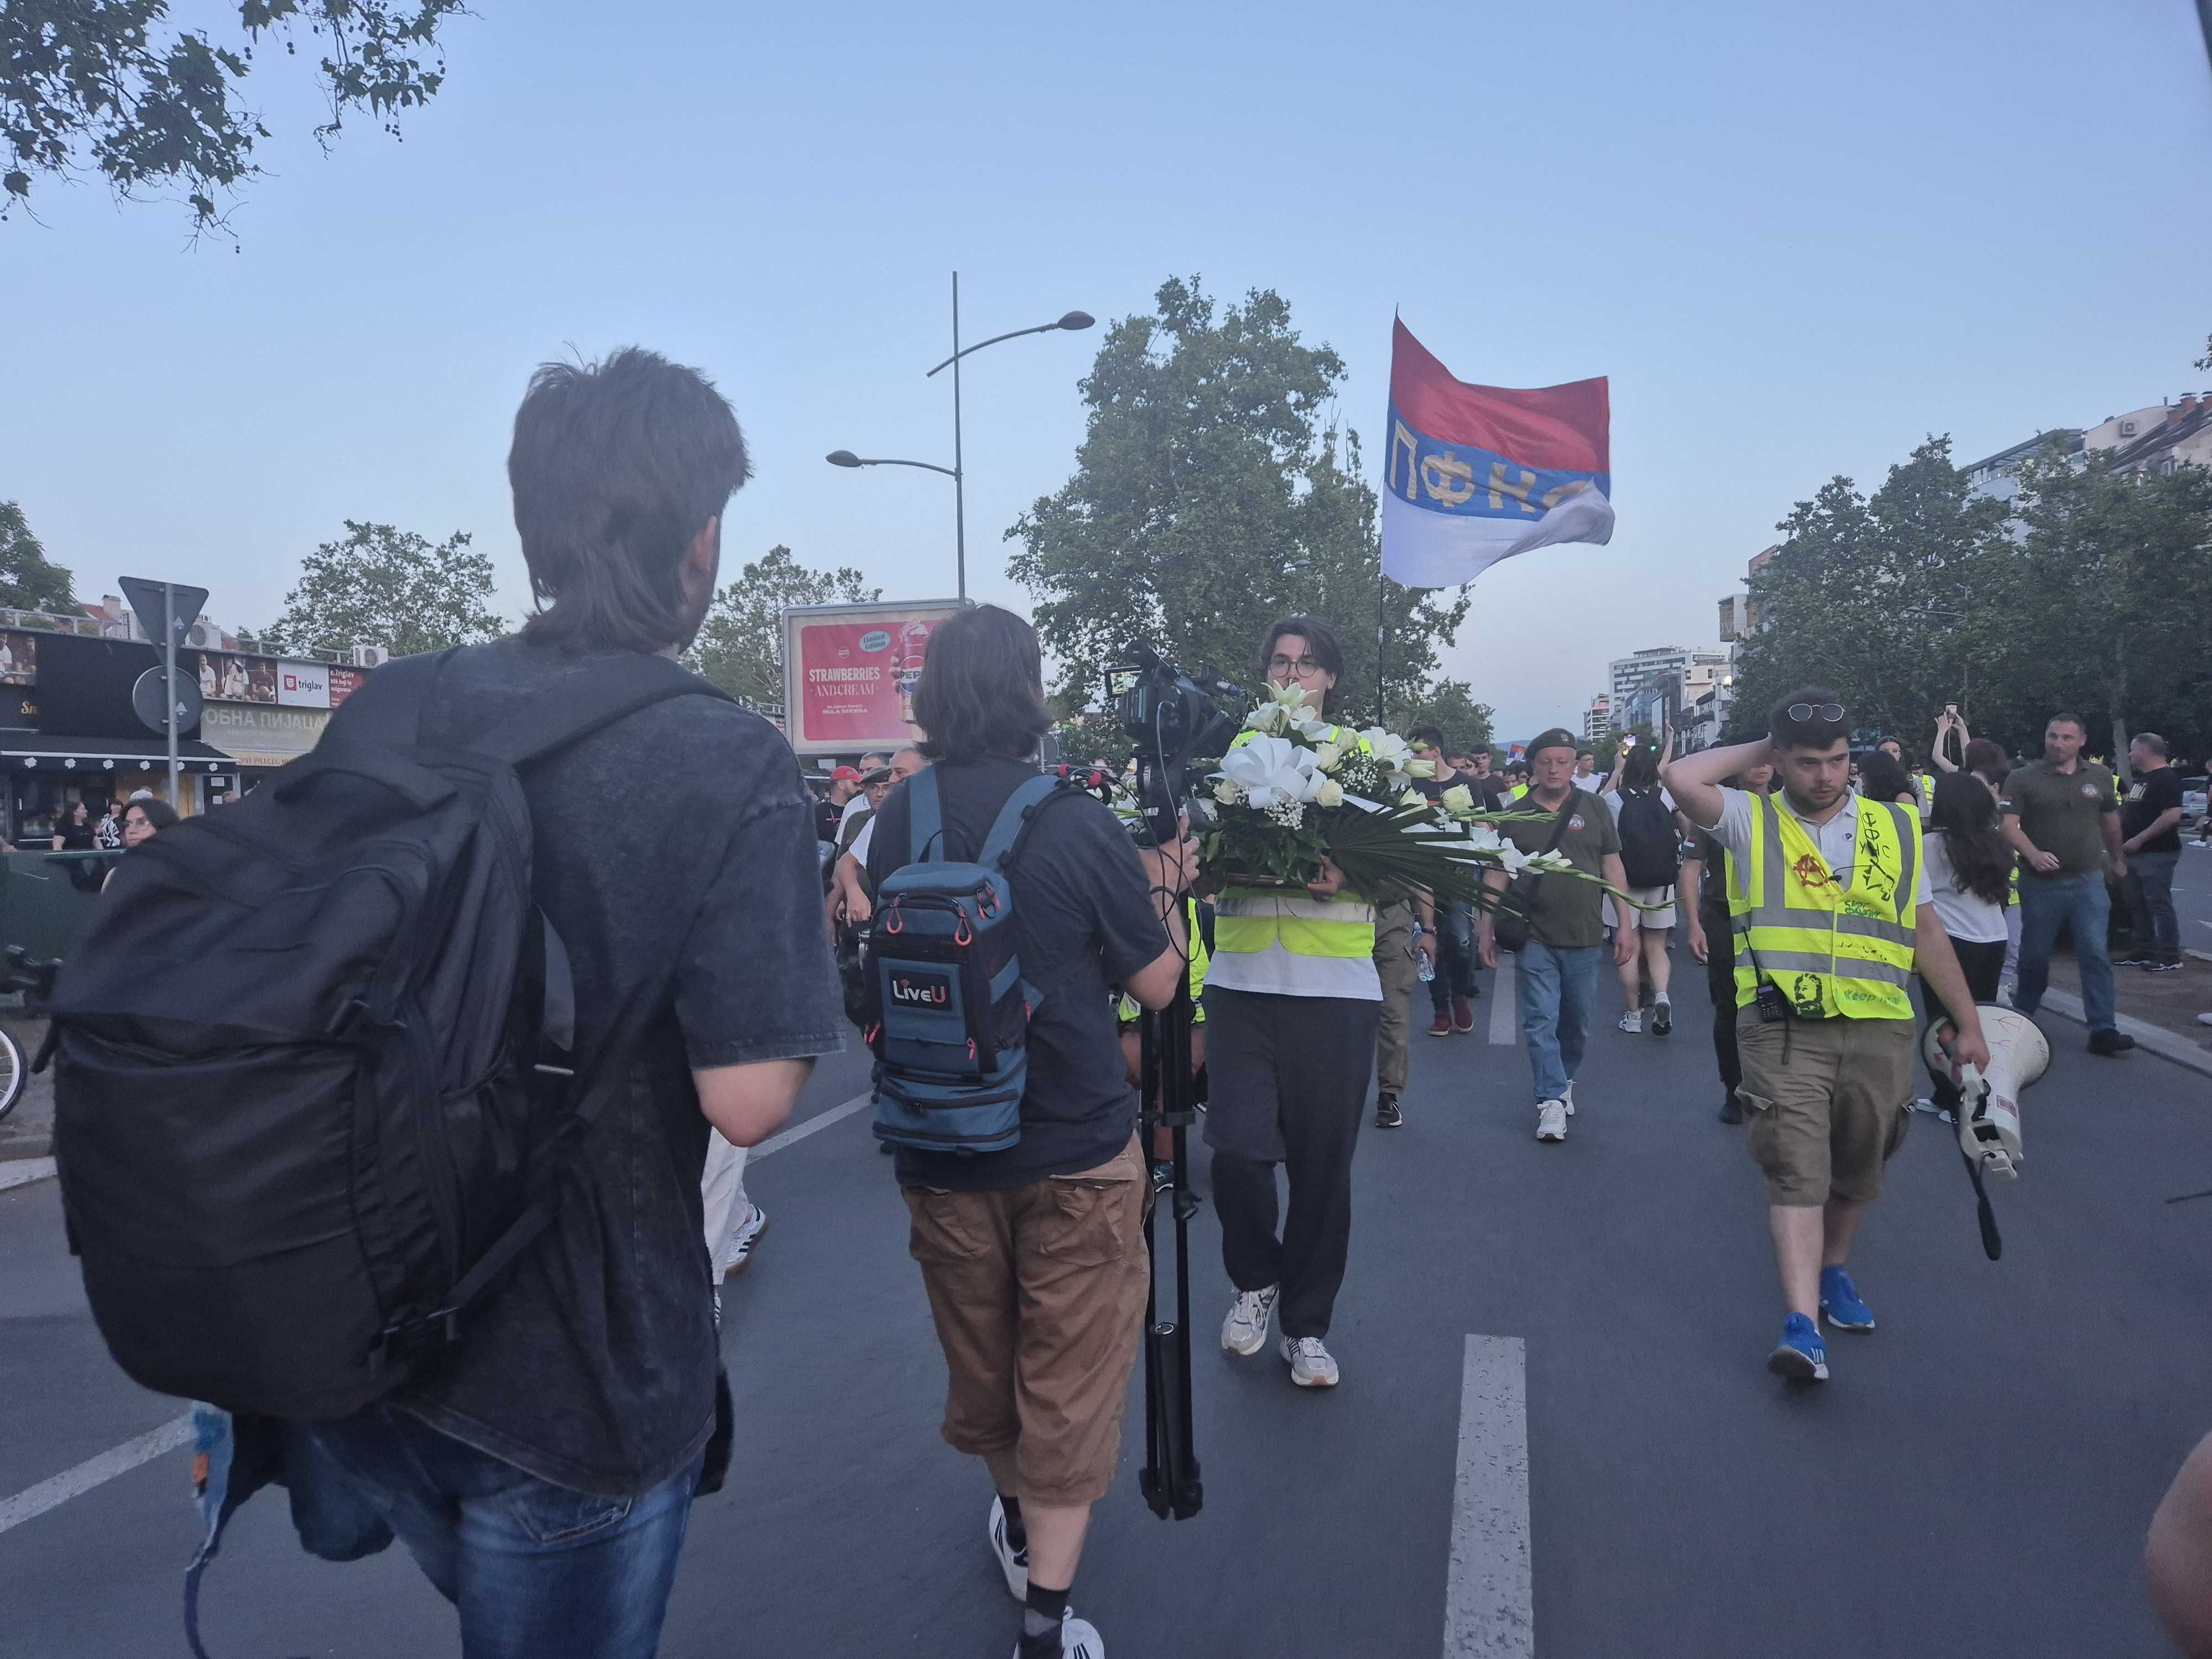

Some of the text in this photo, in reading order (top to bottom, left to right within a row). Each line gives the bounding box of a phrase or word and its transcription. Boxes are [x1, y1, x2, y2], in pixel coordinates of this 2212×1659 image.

[809, 667, 880, 682] STRAWBERRIES
[900, 670, 921, 679] PEP
[299, 680, 322, 691] triglav
[815, 684, 875, 697] AND CREAM
[205, 708, 257, 727] ОБНА
[893, 979, 946, 1003] LiveU
